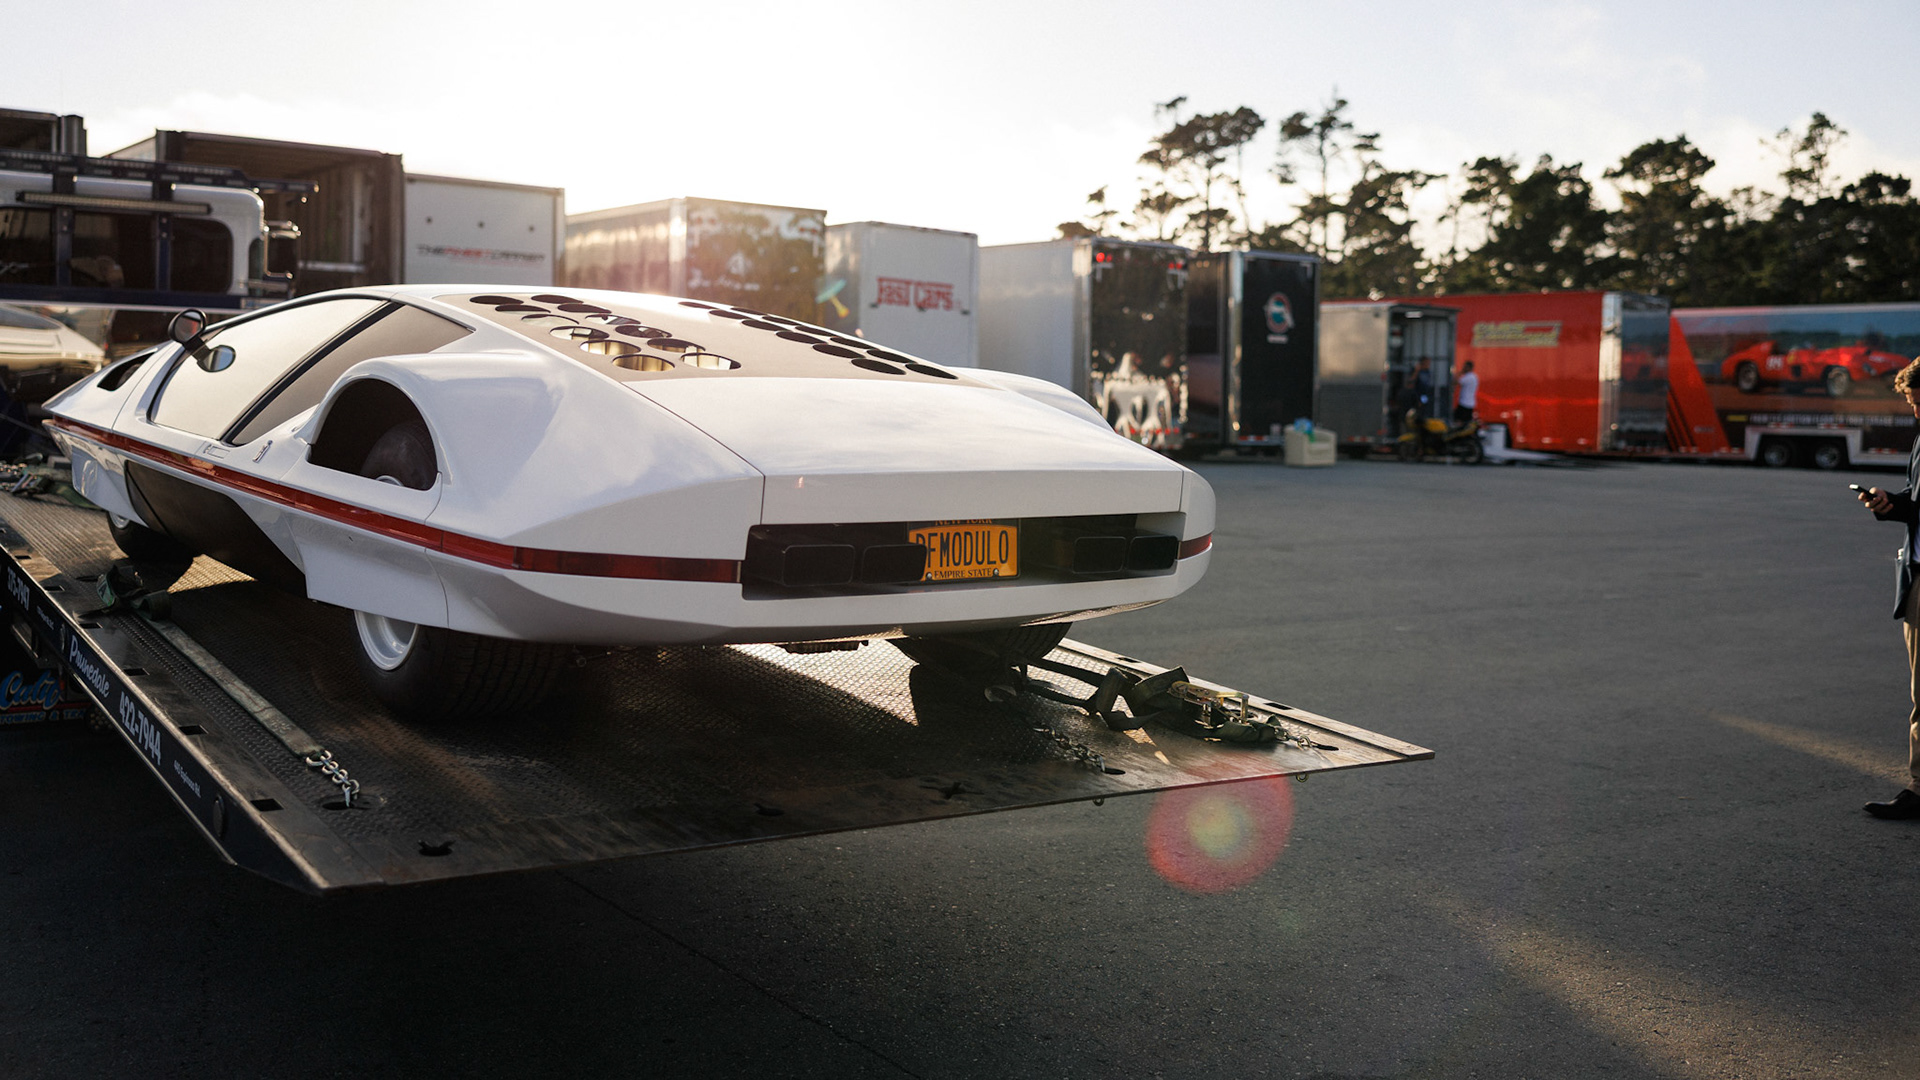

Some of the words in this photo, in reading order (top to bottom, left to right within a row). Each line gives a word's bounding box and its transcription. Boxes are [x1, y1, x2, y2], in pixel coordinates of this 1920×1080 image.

[934, 570, 965, 579] EMPIRE
[968, 567, 991, 577] STATE
[119, 691, 161, 766] 422-7944
